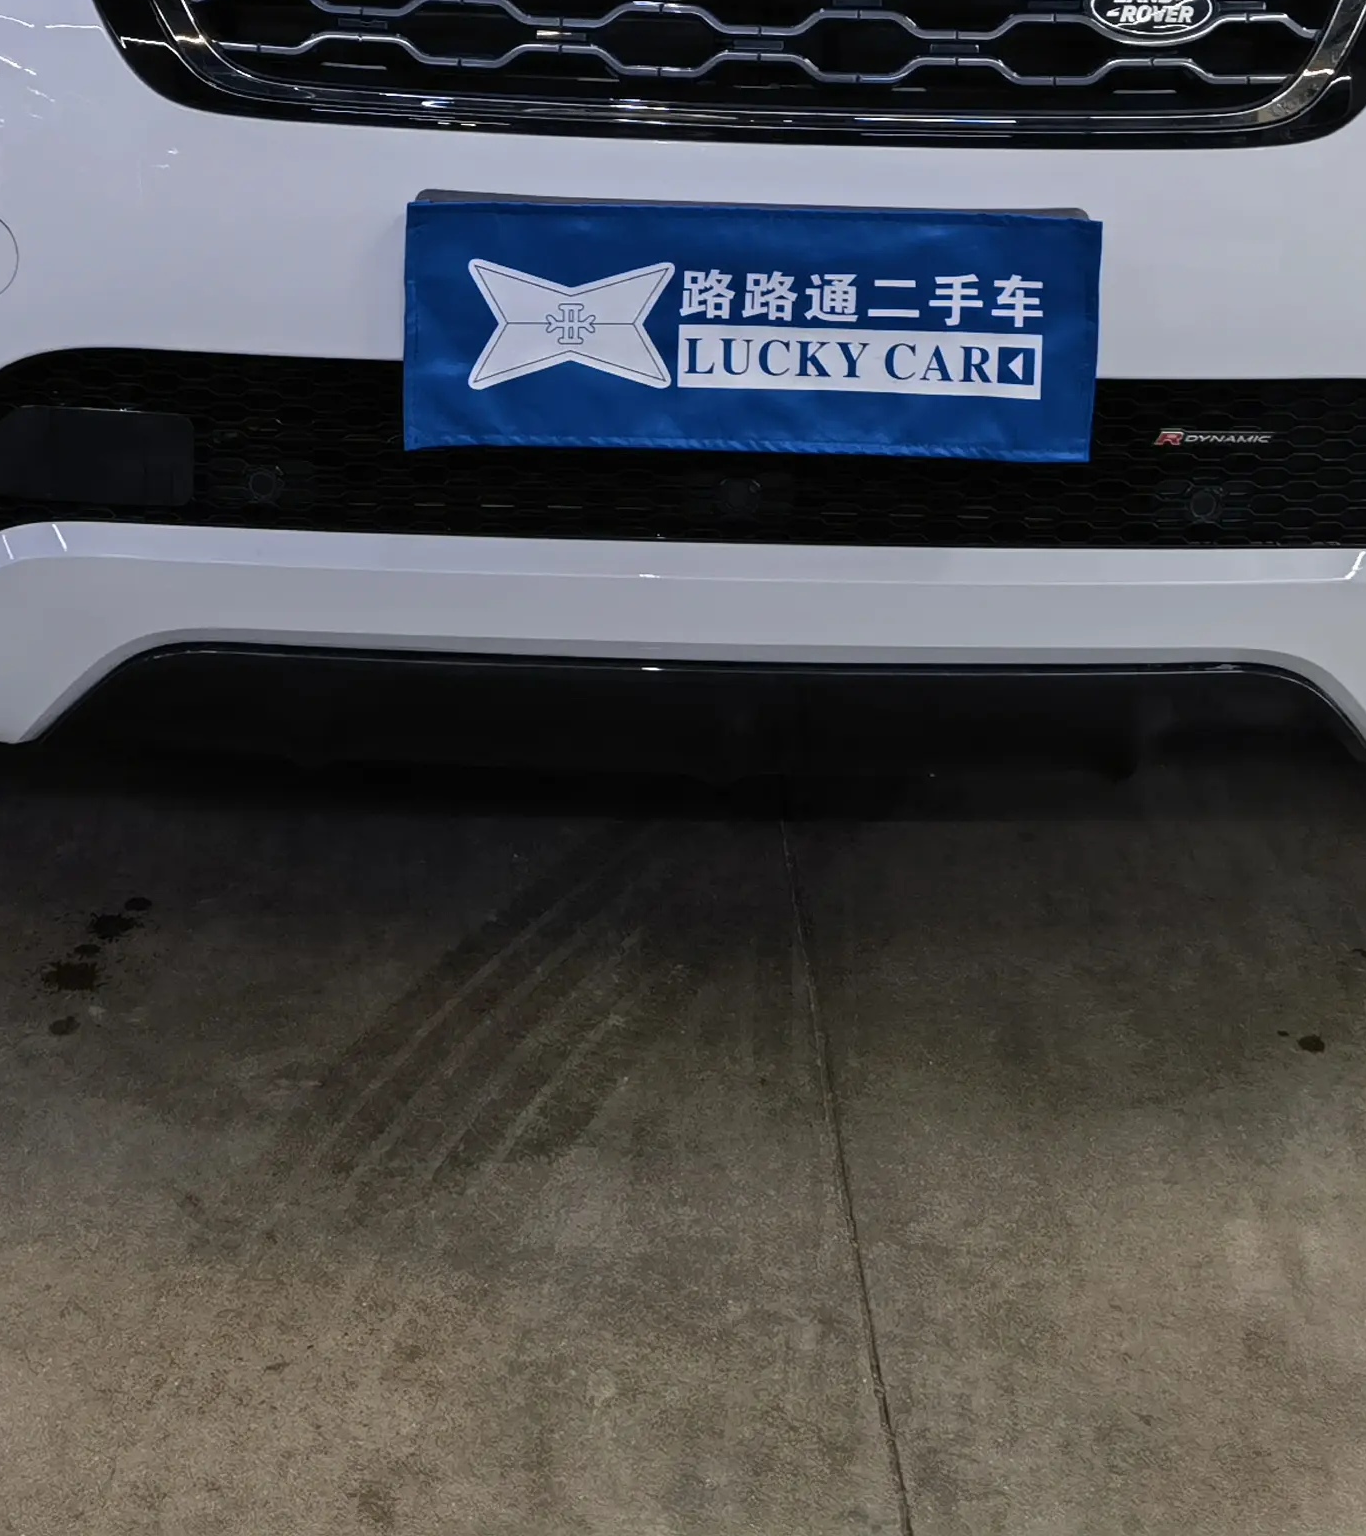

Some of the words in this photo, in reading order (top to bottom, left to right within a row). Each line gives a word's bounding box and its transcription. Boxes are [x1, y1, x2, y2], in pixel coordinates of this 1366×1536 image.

[1119, 4, 1195, 24] ROVER
[678, 269, 1045, 328] 路路通二手车
[683, 336, 870, 382] LUCKY
[883, 344, 993, 385] CAR
[1184, 434, 1272, 444] DYNAMIC
